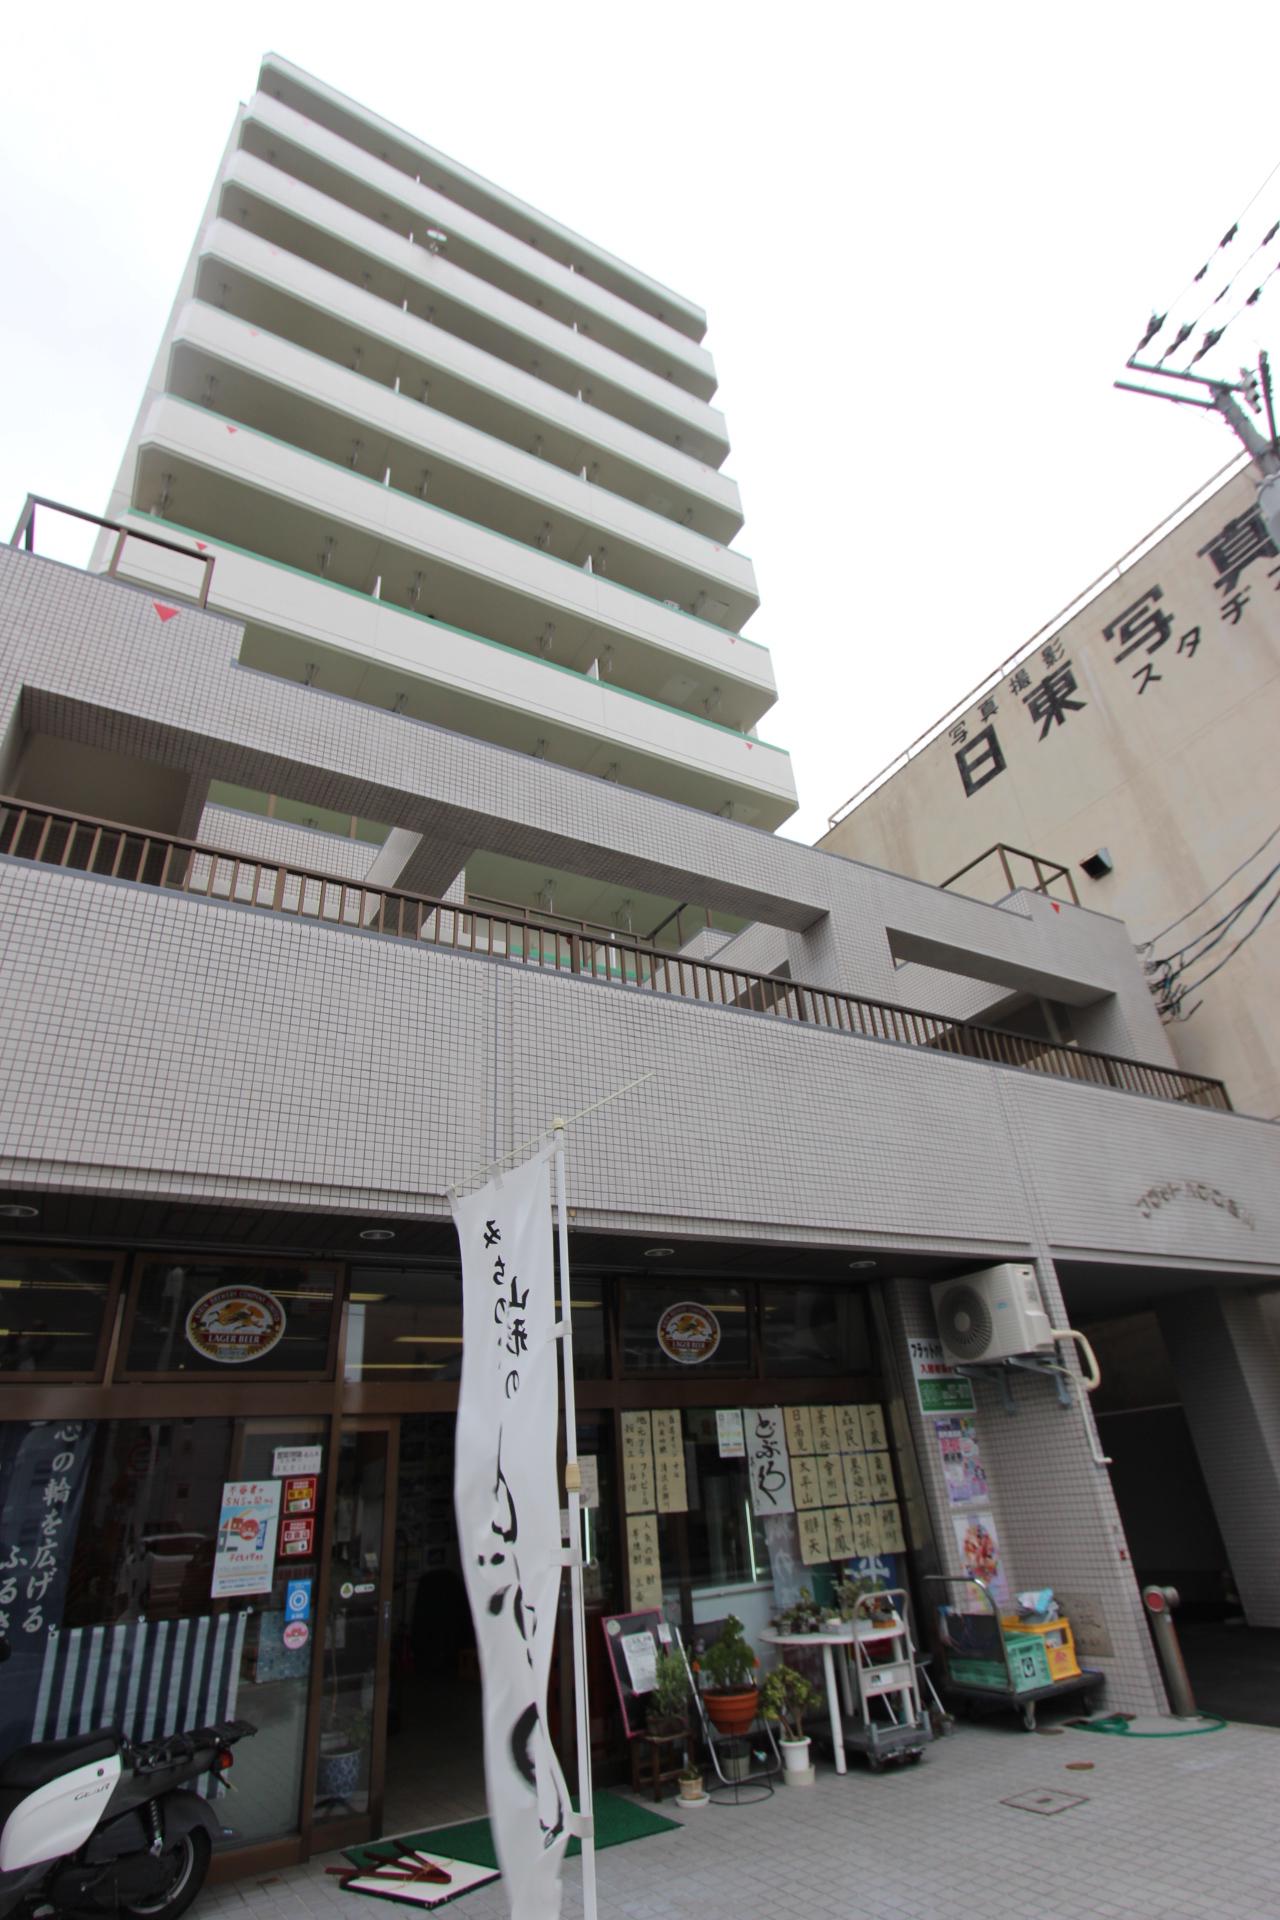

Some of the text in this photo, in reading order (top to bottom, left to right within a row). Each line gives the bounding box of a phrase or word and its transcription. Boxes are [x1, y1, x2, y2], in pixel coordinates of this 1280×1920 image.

[948, 637, 1064, 746] 写真撮影
[954, 502, 1280, 798] 日東写真
[208, 1334, 260, 1344] LAGER BEER
